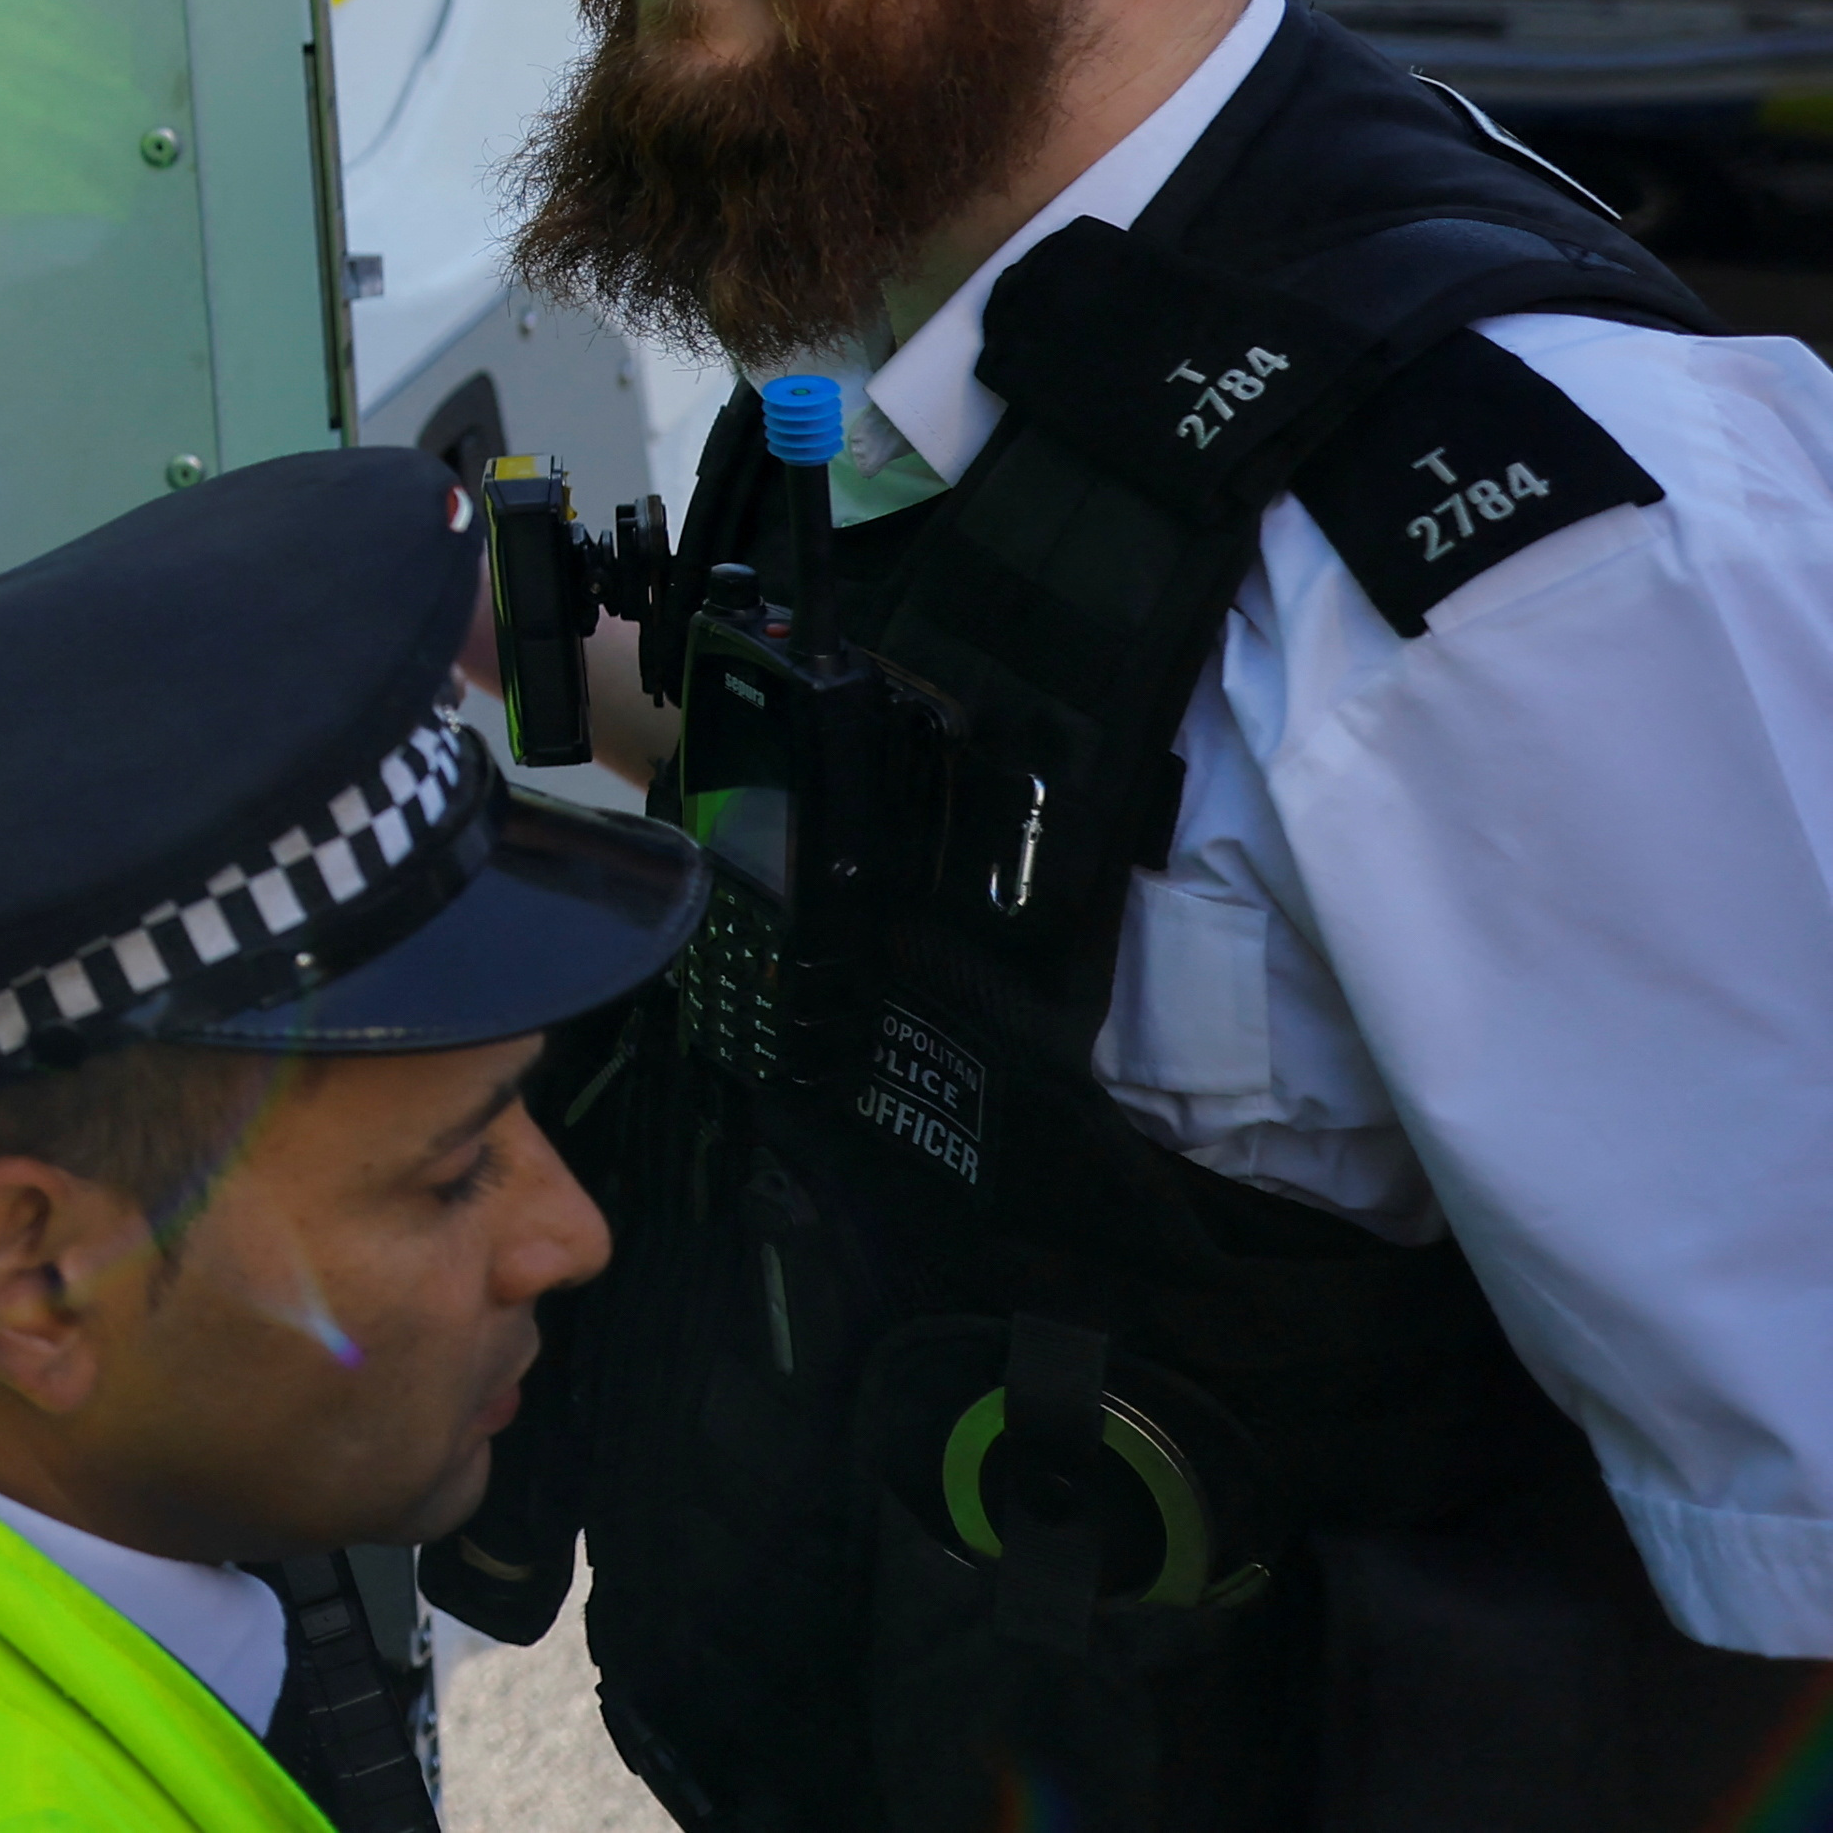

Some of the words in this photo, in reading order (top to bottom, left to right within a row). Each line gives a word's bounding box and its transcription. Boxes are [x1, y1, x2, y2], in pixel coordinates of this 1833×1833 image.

[1166, 359, 1208, 386] T
[1176, 346, 1290, 450] 2784
[1411, 447, 1458, 485] T
[1406, 462, 1551, 563] 2784
[874, 1044, 960, 1109] LICE
[882, 1015, 978, 1092] OPOLITAN
